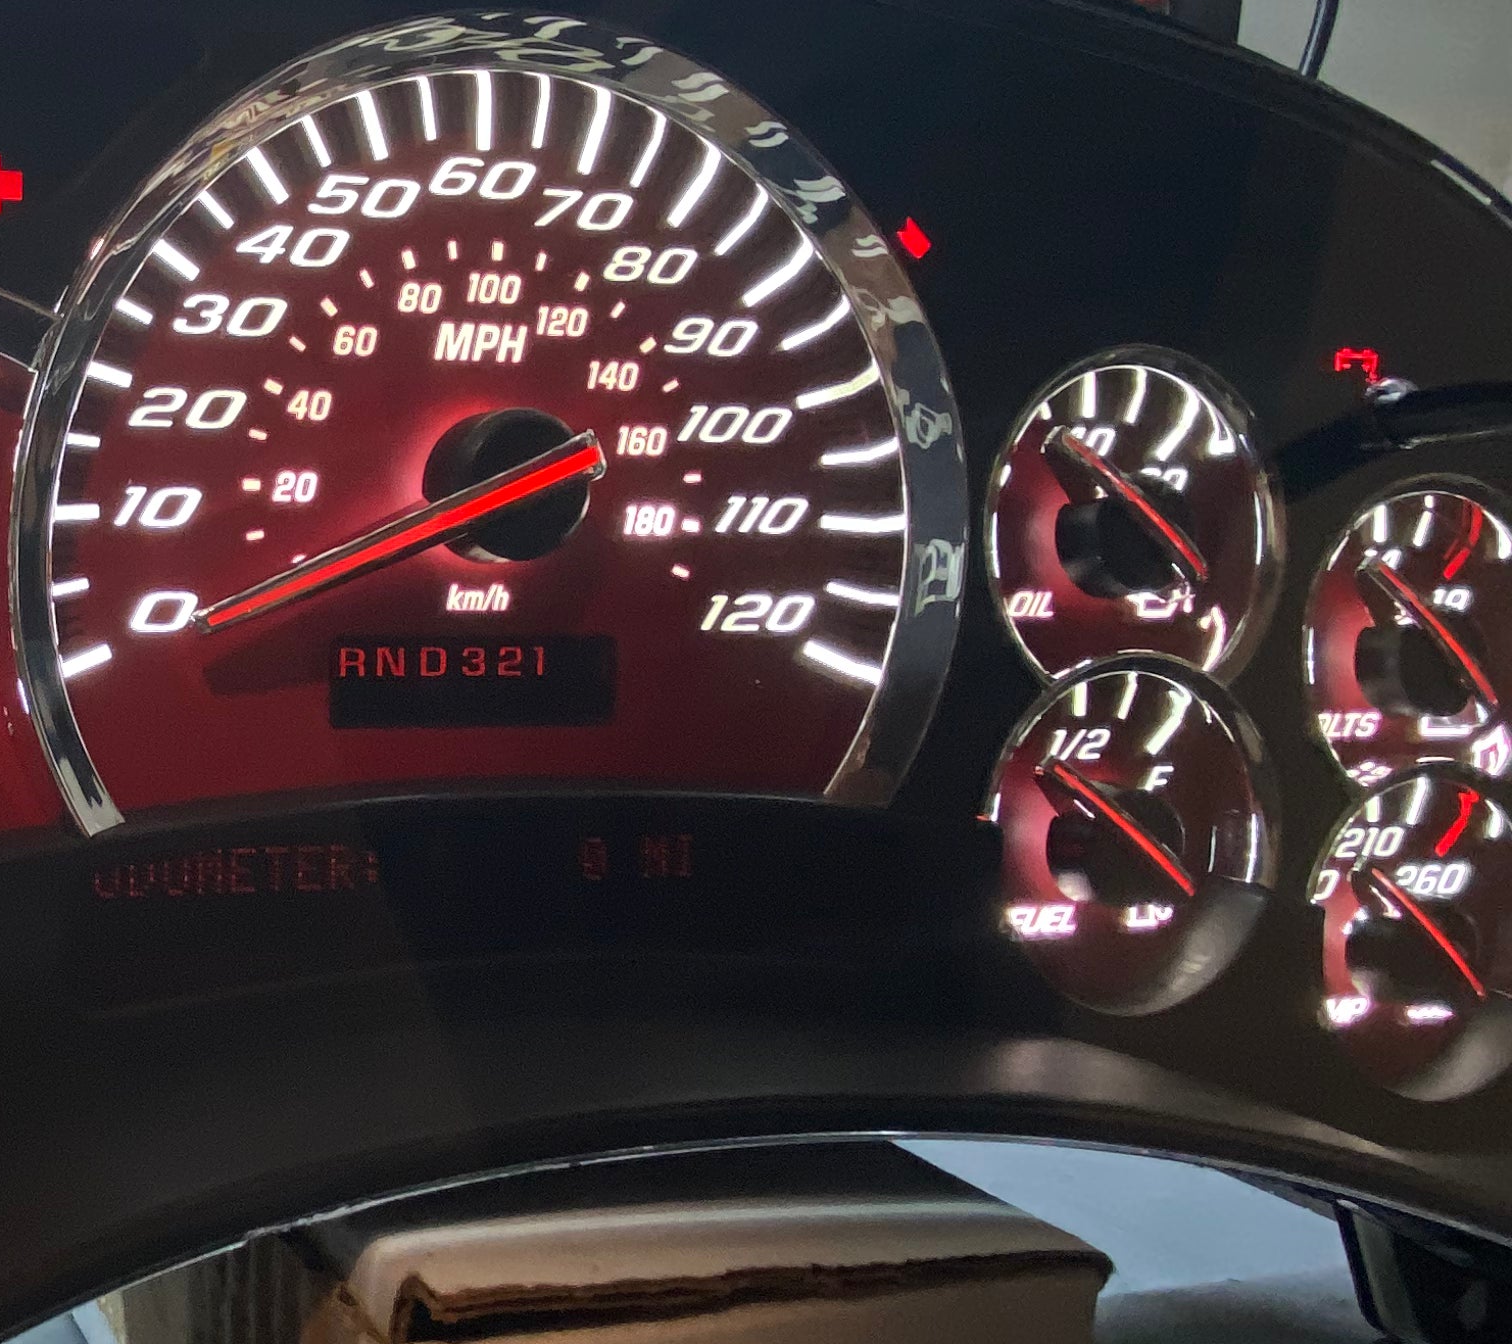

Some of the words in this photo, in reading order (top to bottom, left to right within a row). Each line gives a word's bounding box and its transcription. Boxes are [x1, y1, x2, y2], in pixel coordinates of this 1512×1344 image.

[427, 155, 538, 201] 60
[306, 174, 422, 219] 50
[533, 188, 636, 232] 70
[235, 225, 351, 268] 40
[602, 245, 699, 285] 80
[397, 282, 442, 315] 80
[466, 272, 522, 305] 100
[172, 293, 288, 338] 30
[536, 306, 589, 338] 120
[332, 325, 378, 357] 60
[433, 322, 528, 364] MPH
[663, 317, 759, 358] 90
[587, 361, 640, 392] 140
[127, 386, 248, 430] 20
[286, 389, 333, 422] 40
[616, 425, 668, 457] 160
[676, 404, 793, 445] 100
[271, 470, 319, 504] 20
[113, 485, 203, 530] 10
[622, 504, 676, 537] 180
[714, 496, 810, 535] 110
[127, 590, 193, 634] 0
[445, 583, 510, 612] km/h
[700, 593, 814, 634] 120
[1006, 589, 1055, 618] OIL
[340, 646, 545, 677] RND321
[1048, 728, 1111, 761] 1/2
[1142, 765, 1175, 792] F
[1334, 823, 1406, 859] 210
[1395, 862, 1468, 897] 260
